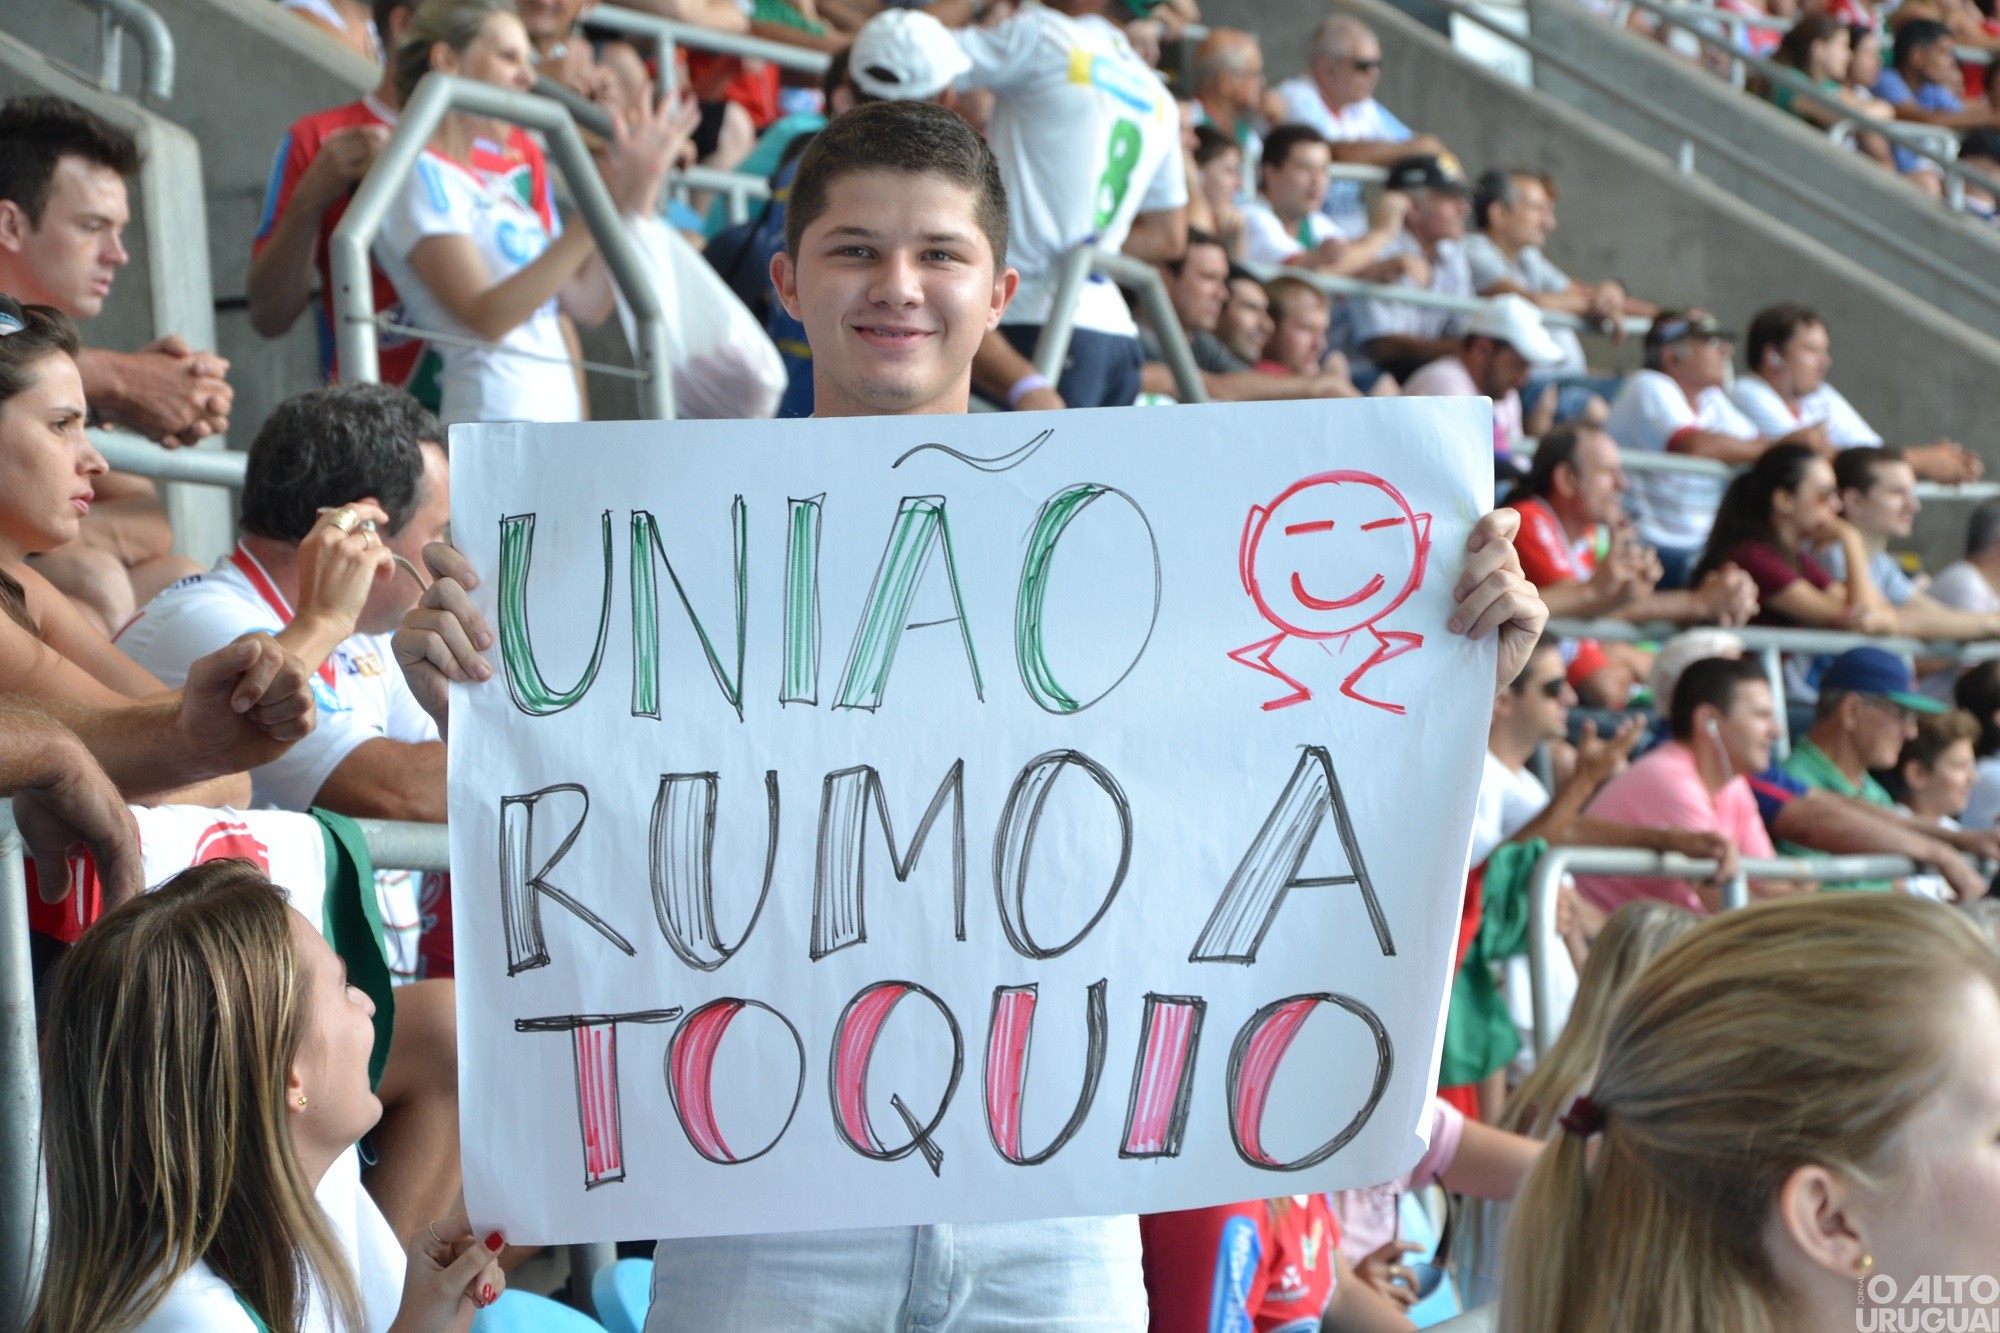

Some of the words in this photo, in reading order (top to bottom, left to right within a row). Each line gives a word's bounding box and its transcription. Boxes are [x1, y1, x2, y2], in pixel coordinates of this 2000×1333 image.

[1095, 116, 1142, 230] 8
[498, 429, 1162, 721] UNIÃO
[500, 749, 1132, 976] RUMO
[1187, 744, 1396, 965] A
[514, 978, 1394, 1190] TOQUIO
